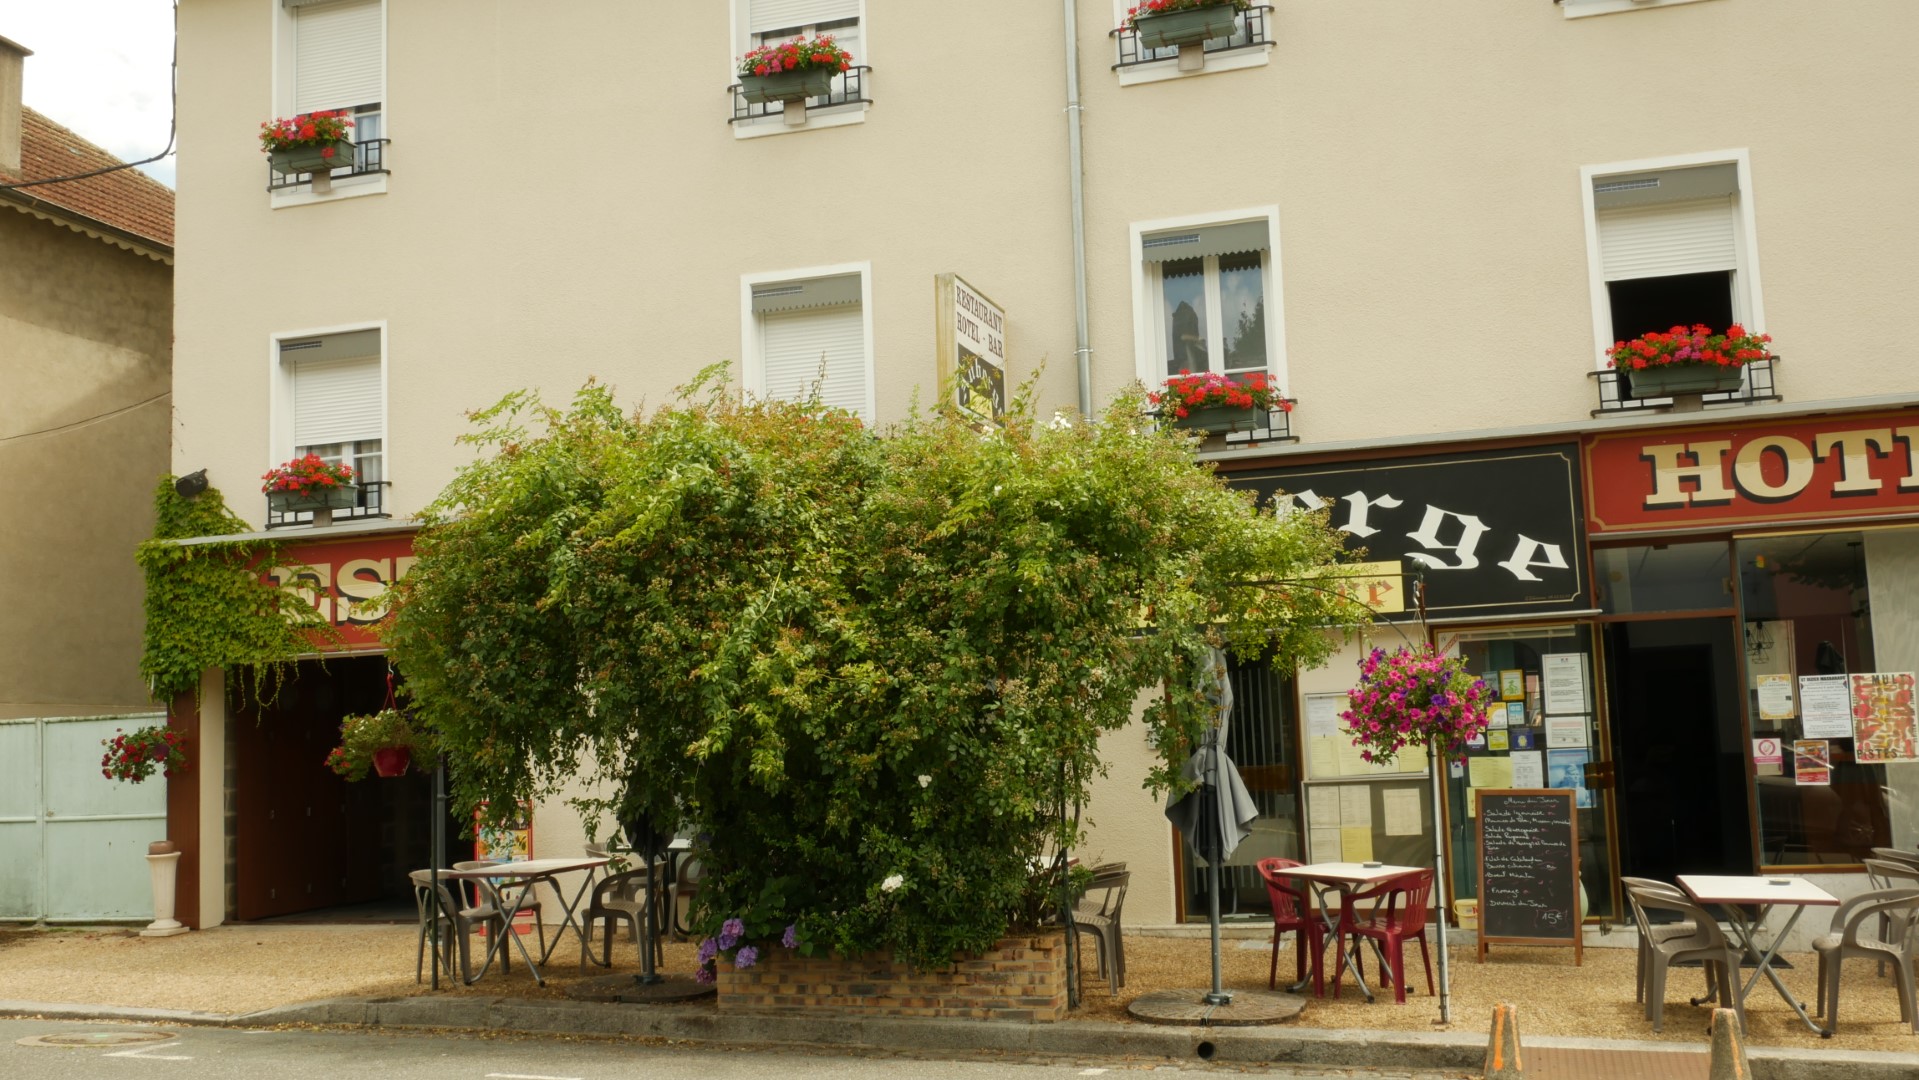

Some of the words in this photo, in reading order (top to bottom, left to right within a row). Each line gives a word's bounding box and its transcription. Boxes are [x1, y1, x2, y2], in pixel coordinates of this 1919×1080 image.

[955, 285, 1003, 335] RESTAURANT
[957, 311, 981, 344] HOTEL
[988, 332, 1003, 358] BAR
[1491, 886, 1520, 898] Fromage
[1541, 911, 1563, 925] 15€
